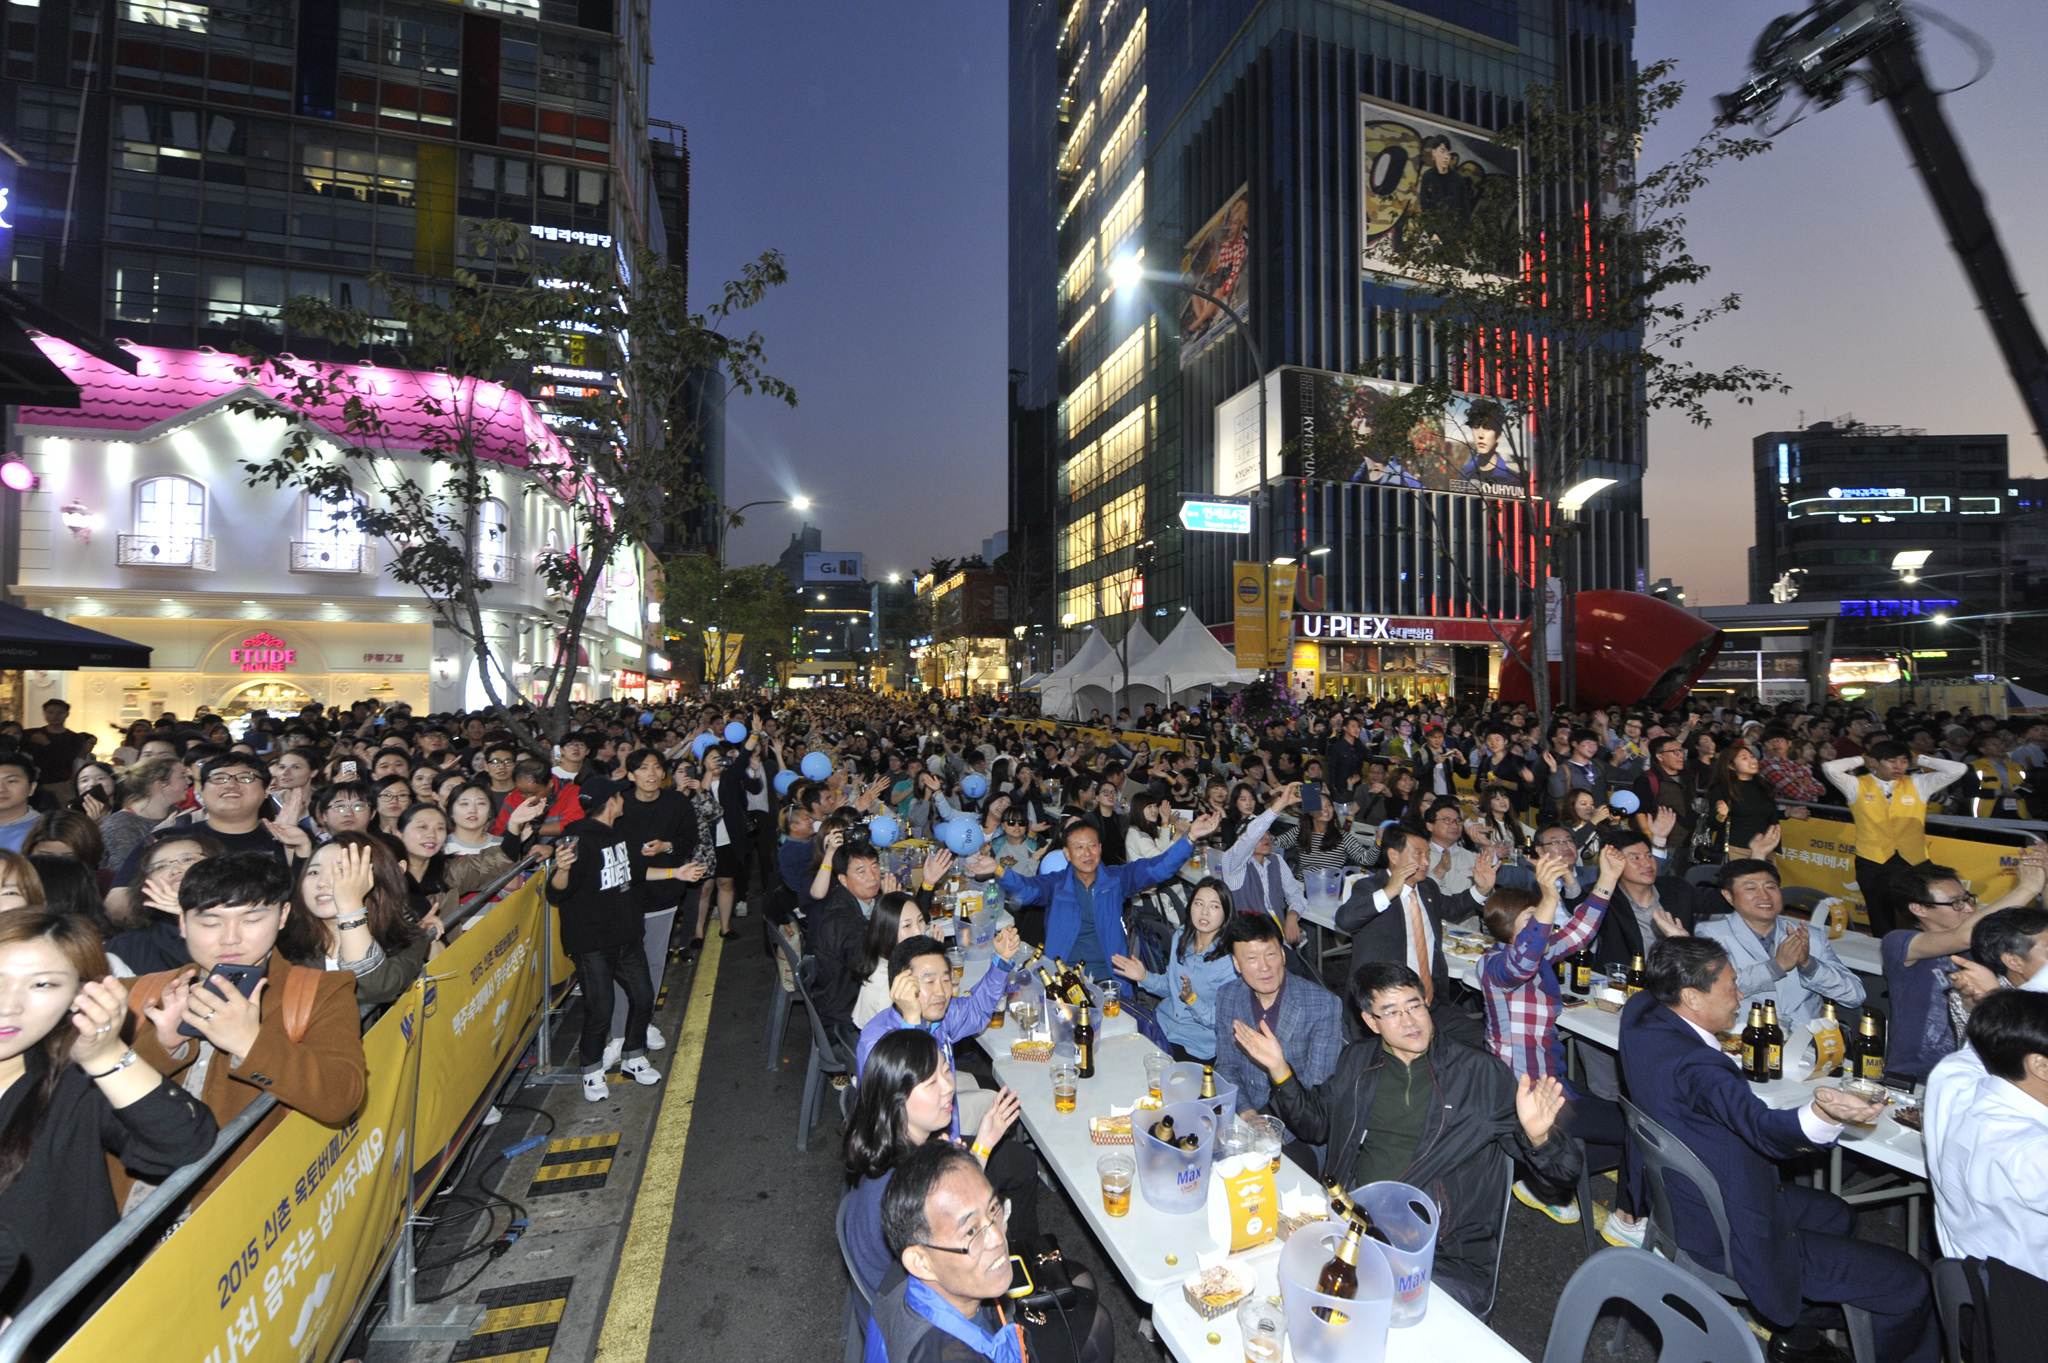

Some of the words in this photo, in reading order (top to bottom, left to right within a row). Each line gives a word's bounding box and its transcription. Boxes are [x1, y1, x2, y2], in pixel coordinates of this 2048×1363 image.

[820, 562, 837, 574] G4
[1303, 614, 1390, 639] U-PLEX
[1389, 626, 1434, 640] 현대백화점
[230, 649, 297, 663] ETUDE
[241, 663, 286, 672] HOUSE
[1810, 839, 1835, 851] 2015
[1999, 856, 2019, 867] Ma
[1177, 1167, 1201, 1185] Max
[203, 1295, 261, 1363] 나친
[263, 1227, 315, 1322] 음주는
[317, 1127, 384, 1240] 삼가주세요
[217, 1237, 259, 1310] 2015
[263, 1196, 292, 1252] 신촌
[1398, 1269, 1427, 1292] Max
